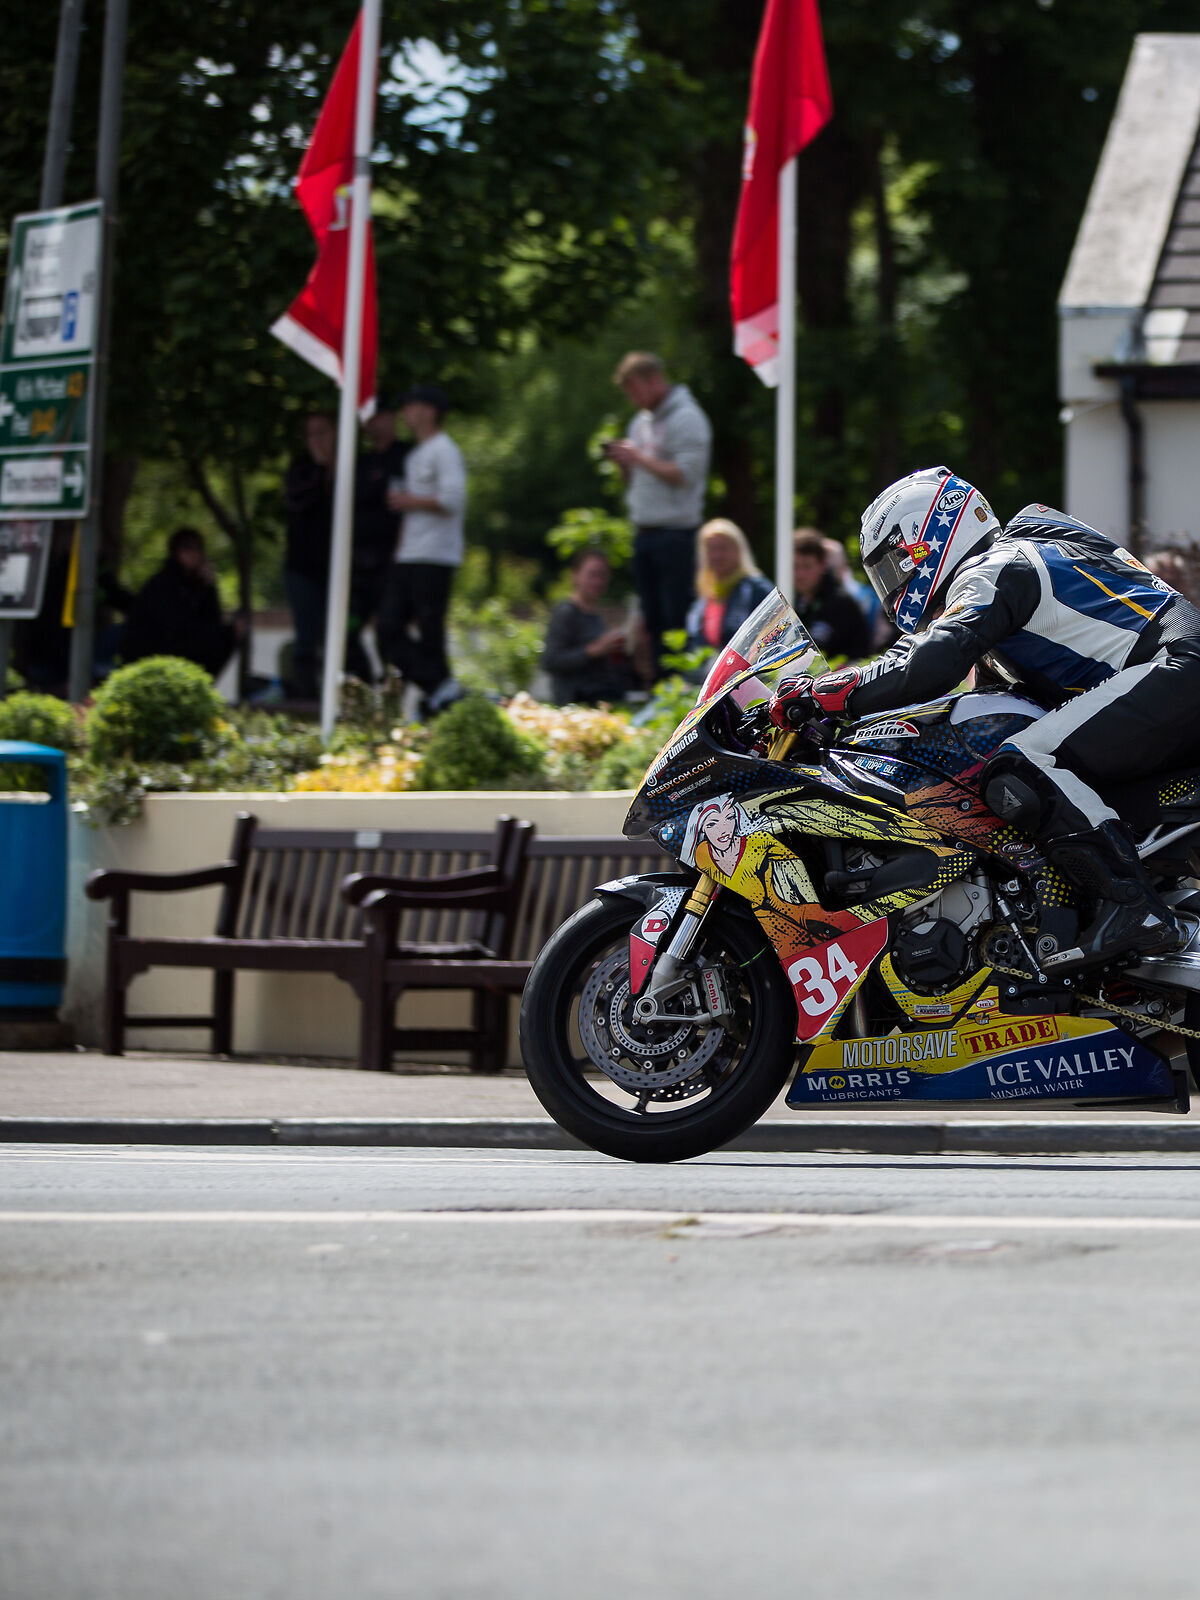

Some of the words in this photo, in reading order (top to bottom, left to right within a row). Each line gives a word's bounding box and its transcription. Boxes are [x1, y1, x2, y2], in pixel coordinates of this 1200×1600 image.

[941, 492, 965, 509] Arai
[646, 756, 718, 799] SPEEDYCOM.CO.UK
[704, 971, 721, 1011] brembo
[787, 942, 859, 1017] 34
[842, 1030, 958, 1069] MOTORSAVE
[965, 1019, 1054, 1054] TRADE
[806, 1070, 911, 1091] MORRIS
[986, 1061, 1032, 1087] ICE
[1033, 1046, 1135, 1080] VALLEY
[822, 1088, 902, 1101] LUBRICANTS
[990, 1085, 1041, 1100] MINERAL
[1044, 1078, 1084, 1094] WATER
